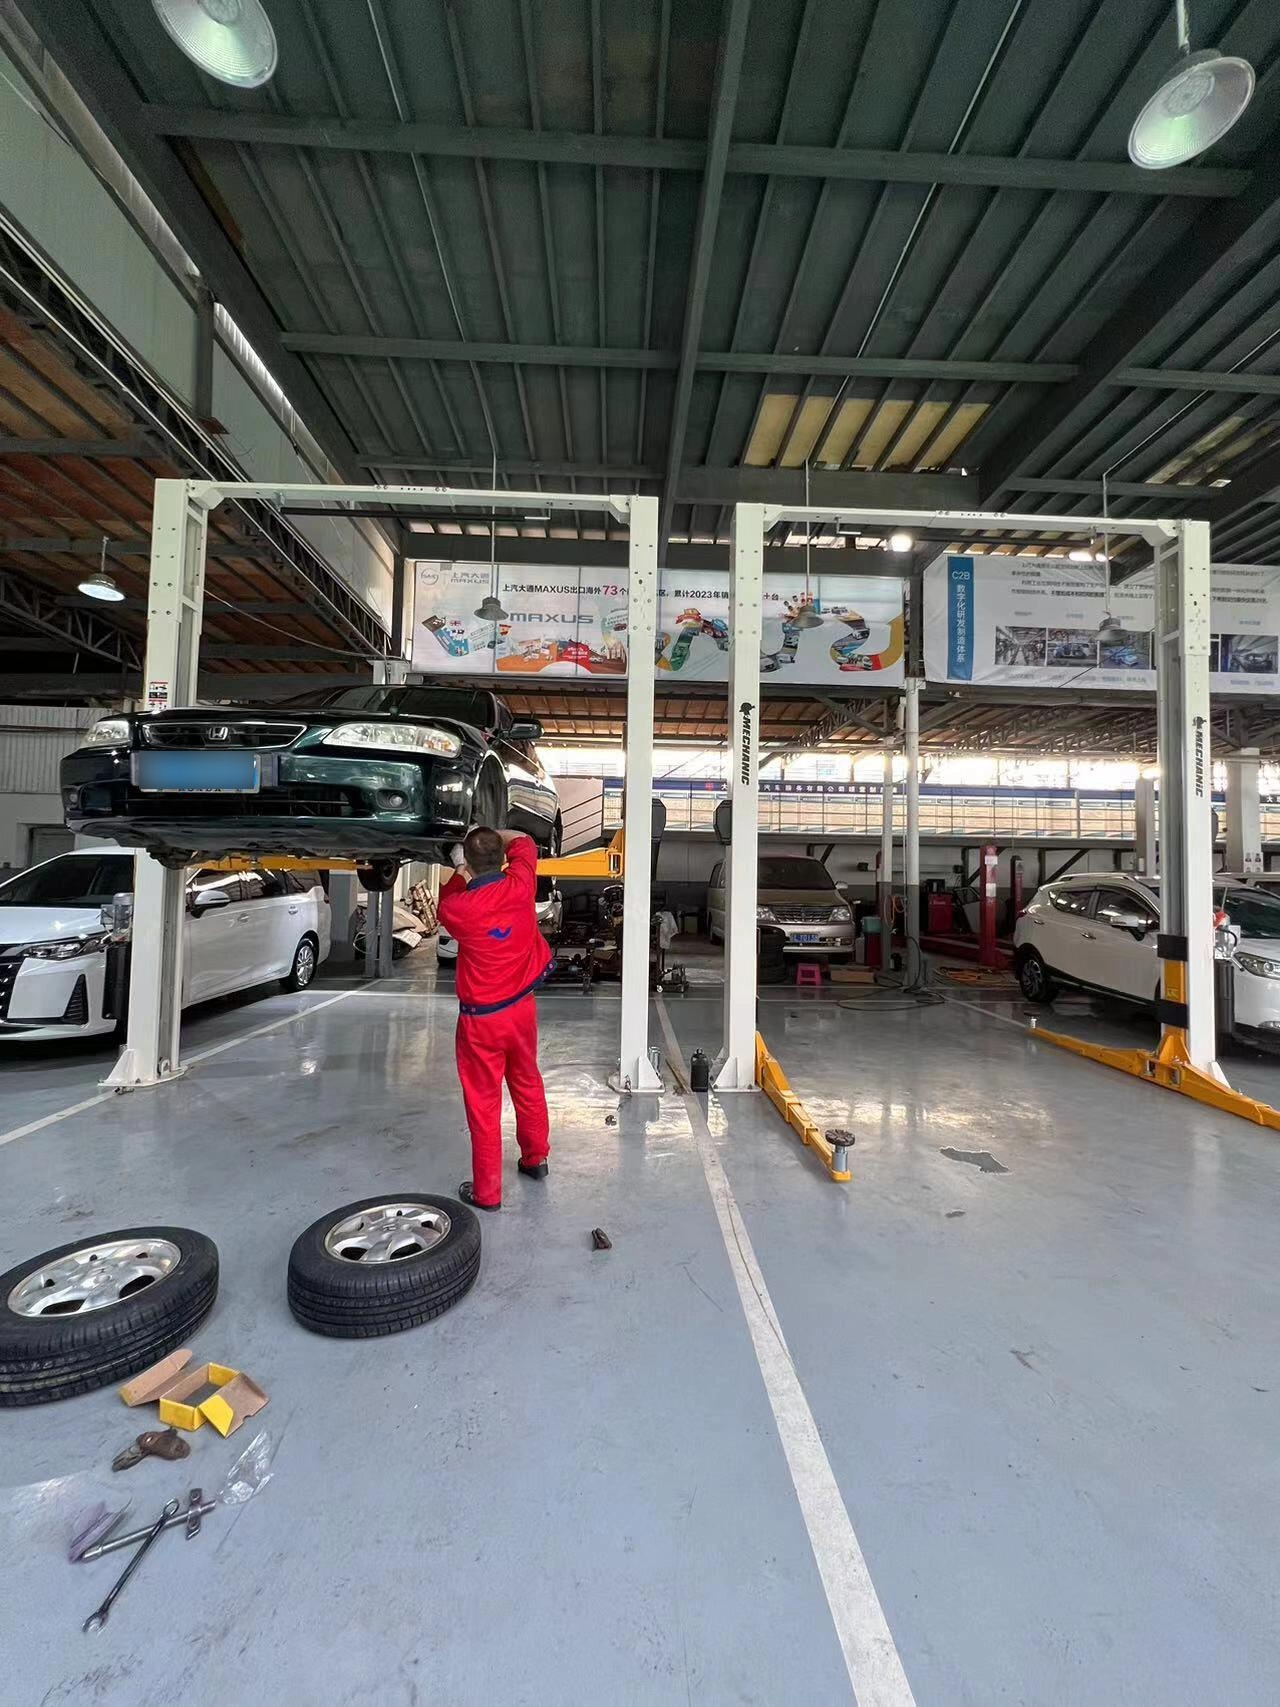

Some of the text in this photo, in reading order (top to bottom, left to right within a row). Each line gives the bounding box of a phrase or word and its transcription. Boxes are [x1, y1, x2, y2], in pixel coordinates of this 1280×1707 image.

[951, 571, 971, 581] C2B
[509, 611, 594, 624] MAXUS
[741, 715, 752, 786] MECHANIC
[1195, 730, 1204, 798] MECHANIC
